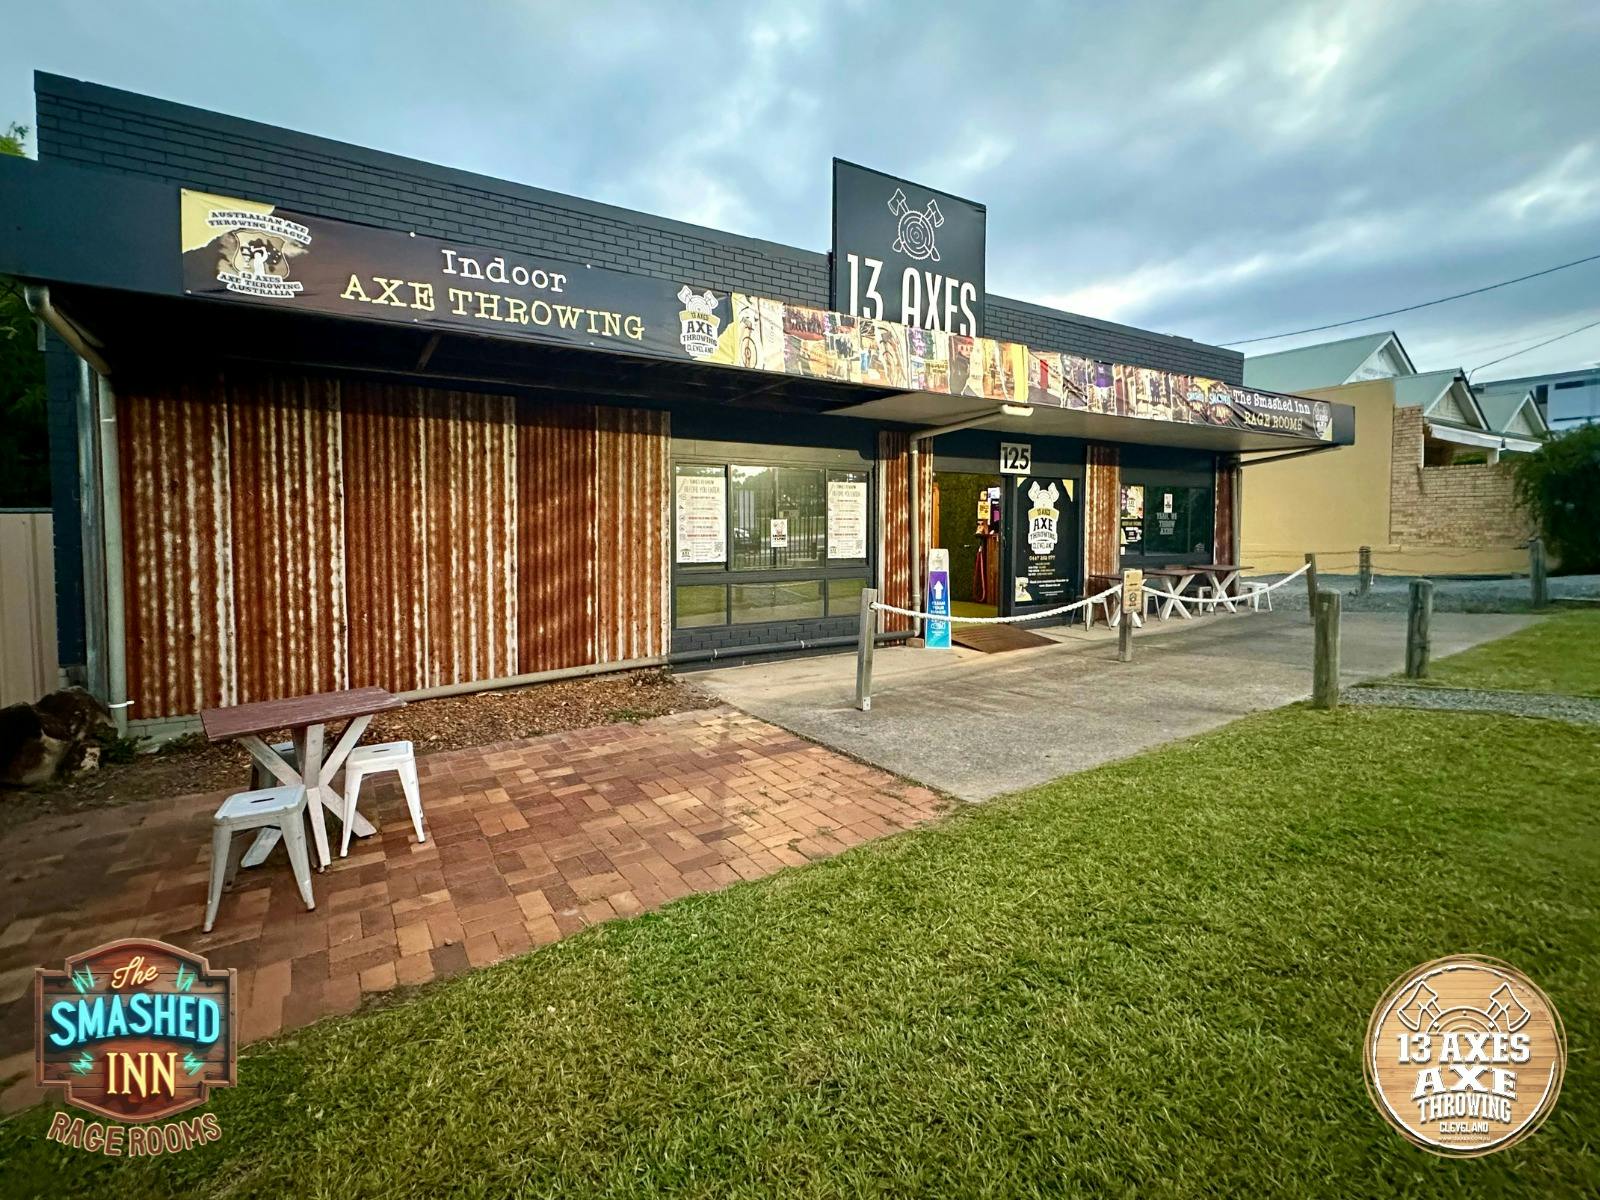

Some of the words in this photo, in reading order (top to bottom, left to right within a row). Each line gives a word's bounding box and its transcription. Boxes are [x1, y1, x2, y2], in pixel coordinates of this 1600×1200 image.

[208, 220, 266, 229] THROWING
[270, 225, 310, 242] LEAGUE
[211, 211, 283, 226] AUSTRALIAN
[287, 222, 308, 233] AXE
[441, 249, 567, 293] Indoor
[220, 275, 242, 284] AXE
[245, 279, 301, 290] THROWING
[231, 283, 292, 296] AUSTRALIA
[847, 253, 884, 320] 13
[901, 266, 977, 337] AXES
[340, 274, 435, 312] AXE
[448, 287, 645, 341] THROWING
[687, 321, 713, 337] AXE
[683, 334, 718, 347] THROWING
[687, 345, 713, 353] CLEVELAND
[1233, 389, 1253, 406] The
[1254, 392, 1293, 412] Smashed
[1294, 399, 1311, 415] Inn
[1243, 410, 1271, 428] RAGE
[1271, 414, 1304, 431] ROOMS
[1001, 446, 1030, 470] 125
[1033, 517, 1053, 532] AXE
[1030, 531, 1057, 541] THROWING
